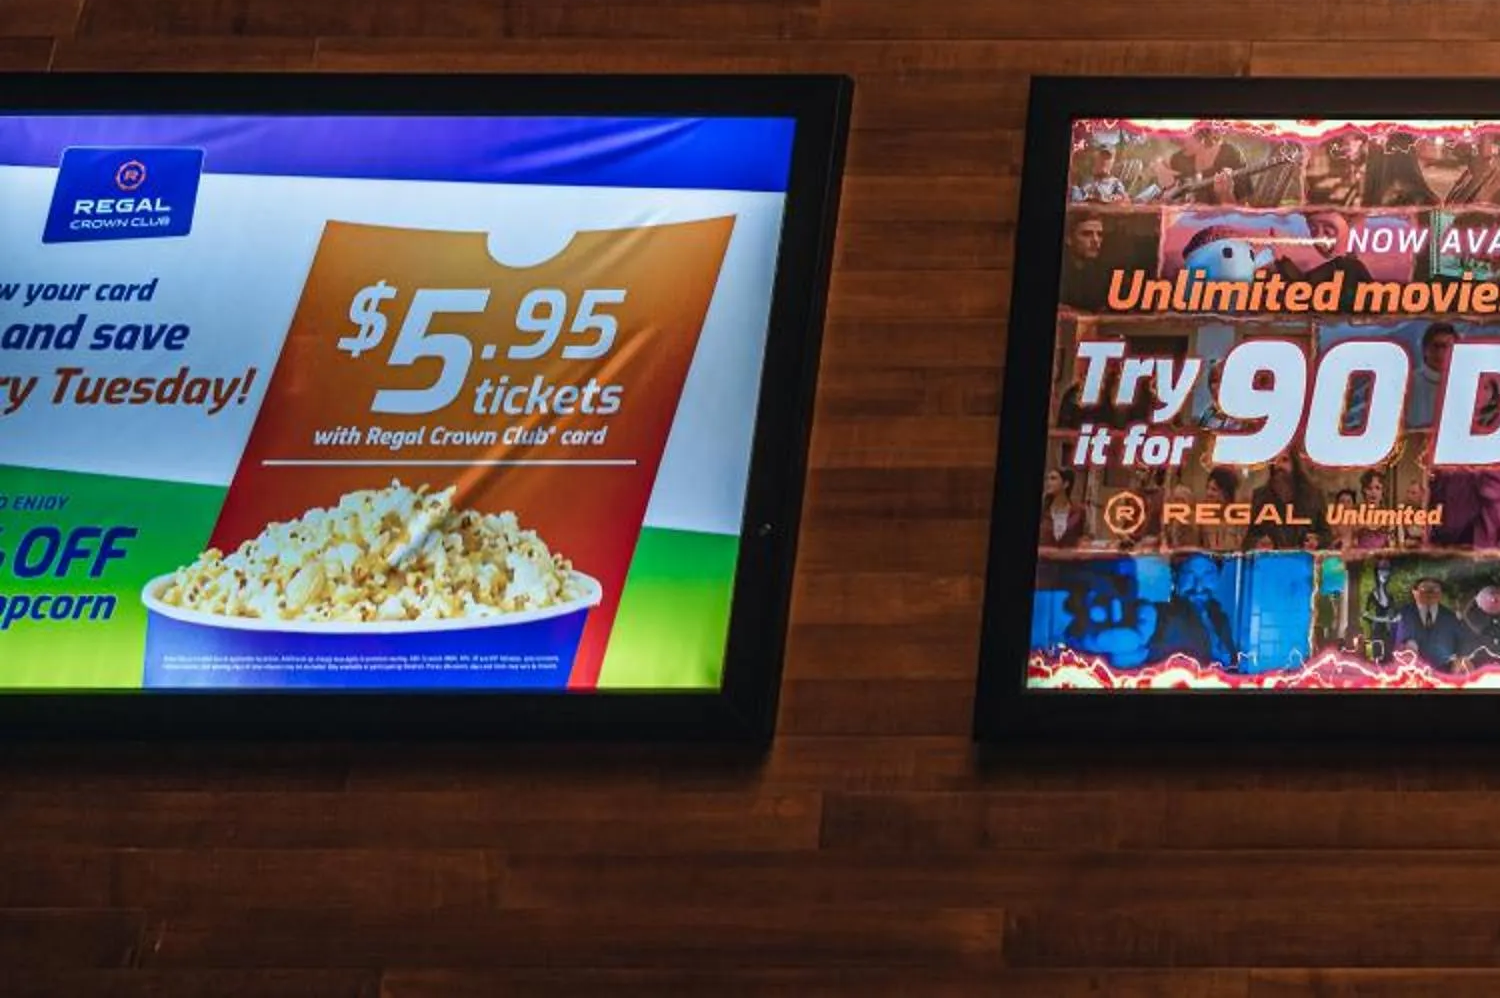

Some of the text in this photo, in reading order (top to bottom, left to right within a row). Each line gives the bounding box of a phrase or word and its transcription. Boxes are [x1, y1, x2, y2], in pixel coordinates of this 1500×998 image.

[69, 216, 171, 231] CROWN CLUB
[73, 198, 171, 215] REGAL
[1346, 228, 1430, 254] NOW
[24, 282, 91, 308] your
[95, 277, 160, 302] card
[1107, 268, 1345, 312] Unlimited
[1, 314, 191, 351] and save
[336, 279, 628, 415] $5.95
[51, 366, 258, 416] Tuesday!
[472, 374, 625, 416] tickets
[1076, 340, 1202, 424] Try
[1211, 339, 1411, 466] 90
[313, 425, 361, 447] with
[364, 425, 424, 451] Regal
[428, 426, 498, 447] Crown
[560, 425, 609, 446] card
[1073, 423, 1194, 466] it for
[12, 495, 71, 511] ENJOY
[1162, 503, 1312, 526] REGAL
[1325, 503, 1443, 527] Unlimited
[12, 525, 139, 579] OFF
[0, 594, 117, 631] pcorn
